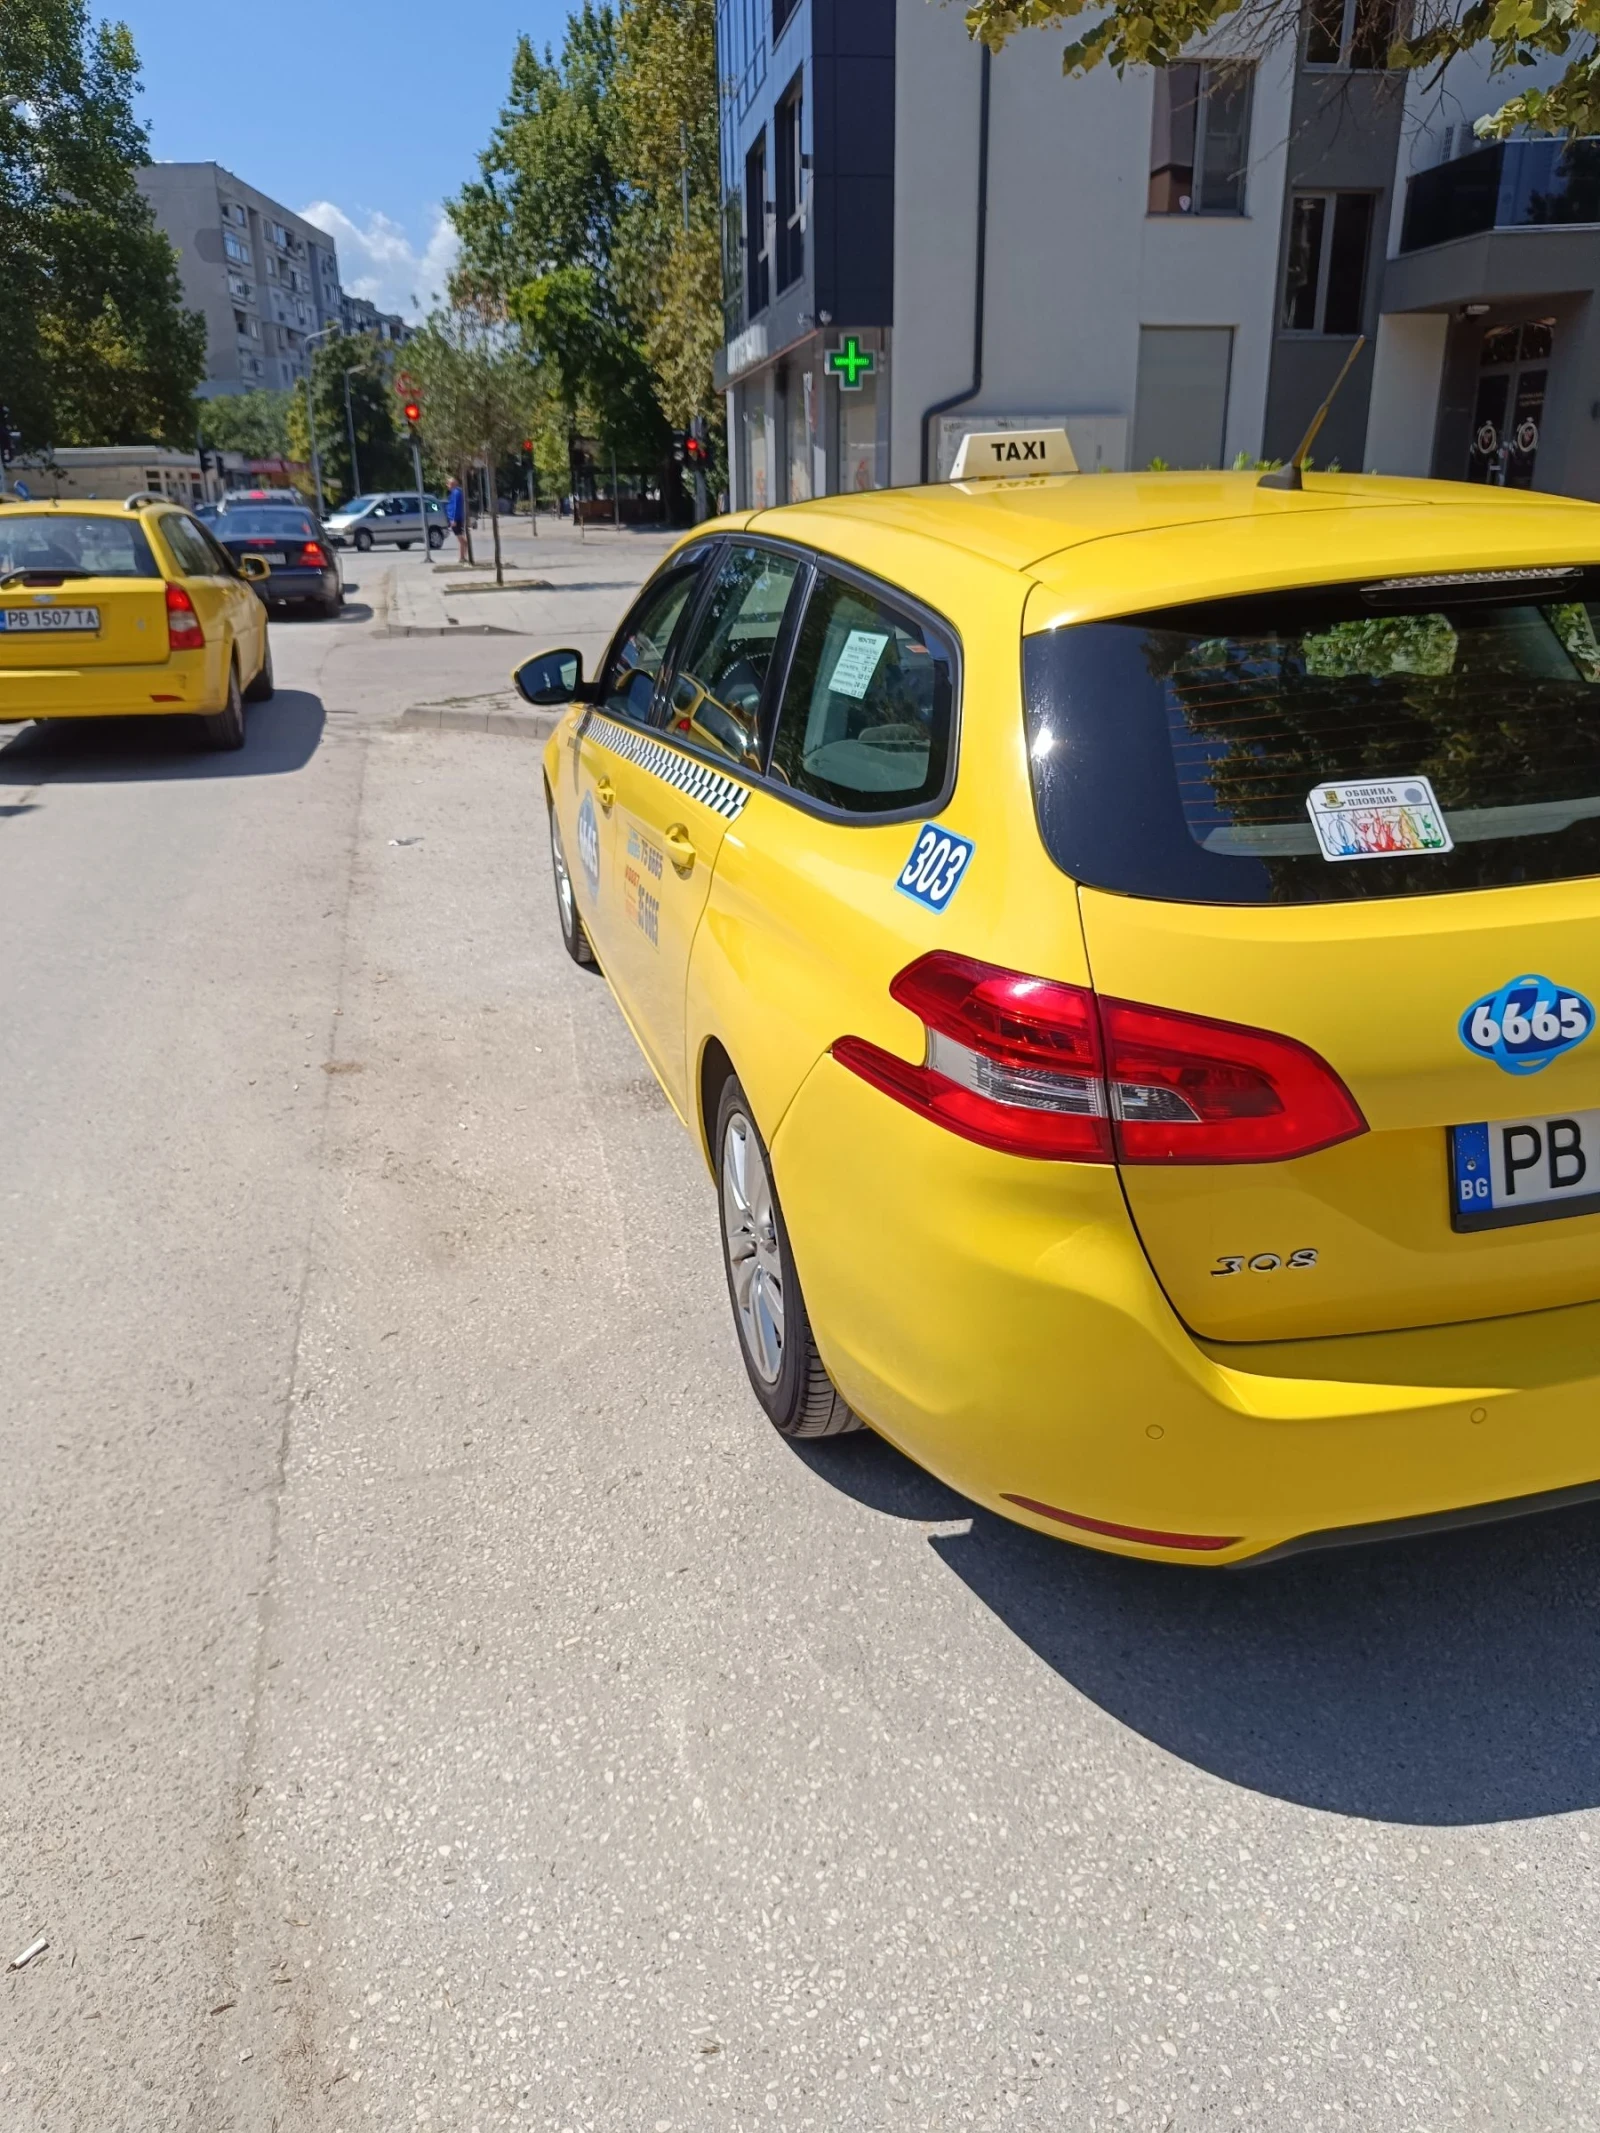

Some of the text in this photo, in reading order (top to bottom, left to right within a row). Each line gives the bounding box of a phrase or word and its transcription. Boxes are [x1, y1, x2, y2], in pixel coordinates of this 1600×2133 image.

[991, 441, 1046, 461] TAXI
[8, 610, 96, 627] PB 1507 TA
[1345, 788, 1394, 798] ОБЩИНА
[1347, 795, 1397, 806] ПЛОВДИВ
[902, 831, 967, 901] 303
[1471, 998, 1587, 1047] 6665
[1502, 1118, 1586, 1196] PB
[1460, 1177, 1489, 1201] BG
[1210, 1248, 1319, 1277] 308
